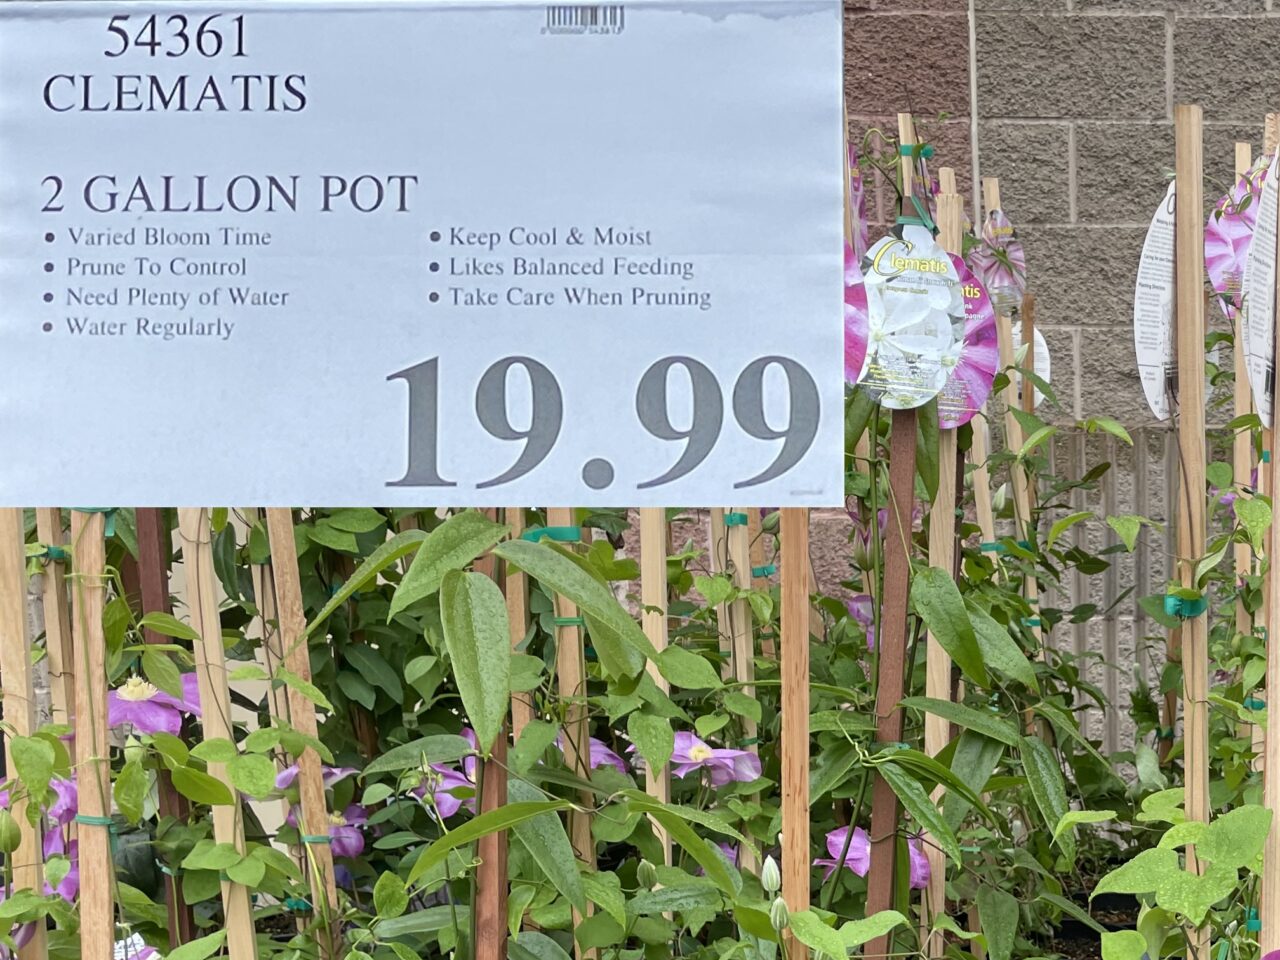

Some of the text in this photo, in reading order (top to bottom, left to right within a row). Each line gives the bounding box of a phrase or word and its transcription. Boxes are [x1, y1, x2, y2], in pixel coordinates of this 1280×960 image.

[103, 13, 249, 57] 54361
[42, 73, 308, 112] CLEMATIS
[41, 174, 419, 213] 2 GALLON POT
[67, 226, 272, 246] Varied Bloom Time
[449, 226, 652, 252] Keep Cool & Moist
[67, 256, 247, 276] Prune To Control
[449, 256, 695, 281] Likes Balanced Feeding
[873, 239, 948, 276] Clematis
[66, 286, 289, 312] Need Plenty of Water
[448, 286, 712, 312] Take Care When Pruning
[66, 316, 236, 342] Water Regularly
[384, 353, 821, 491] 19.99
